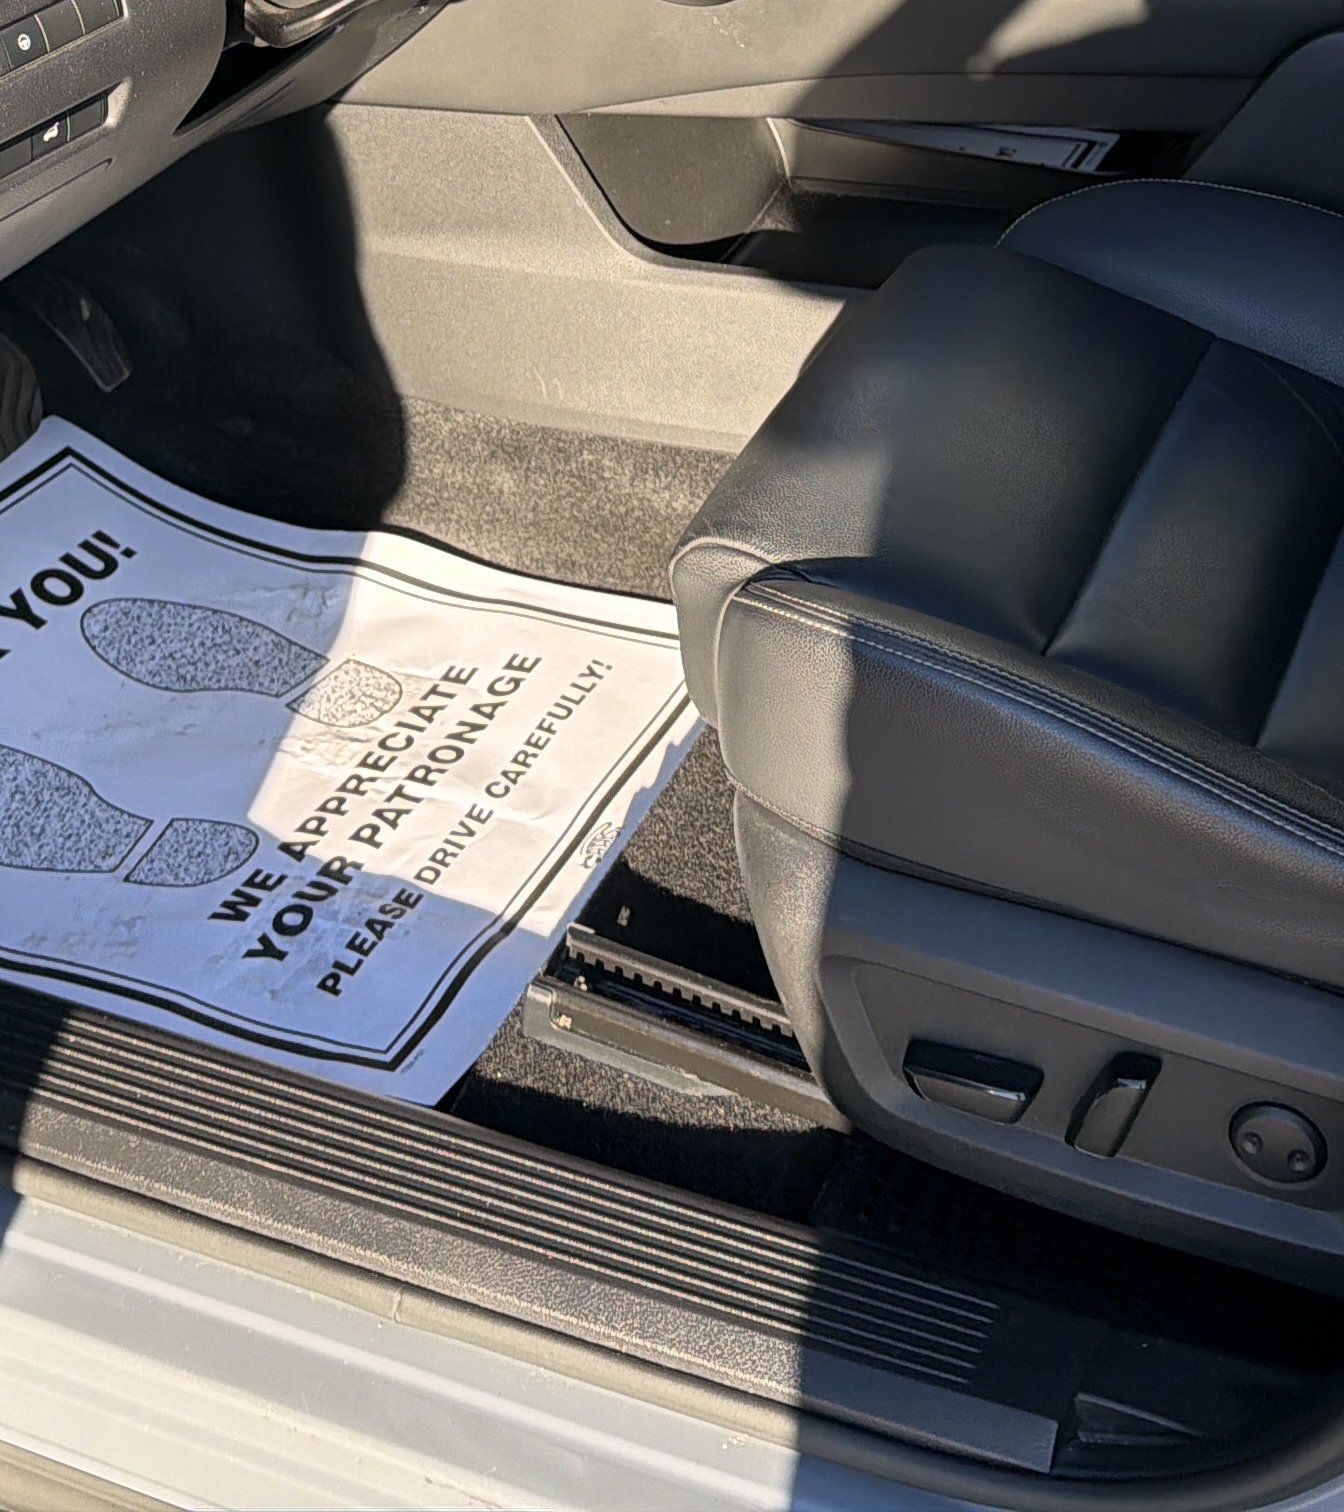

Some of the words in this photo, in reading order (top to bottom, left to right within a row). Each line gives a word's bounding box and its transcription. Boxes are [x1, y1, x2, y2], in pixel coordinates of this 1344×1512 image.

[208, 868, 288, 923] WE
[277, 665, 480, 863] APPRECIATE
[241, 855, 364, 962] YOUR
[348, 653, 543, 850] PATRONAGE
[316, 888, 424, 997] PLEASE
[413, 803, 495, 885] DRIVE
[484, 659, 614, 799] CAREFULLY!
